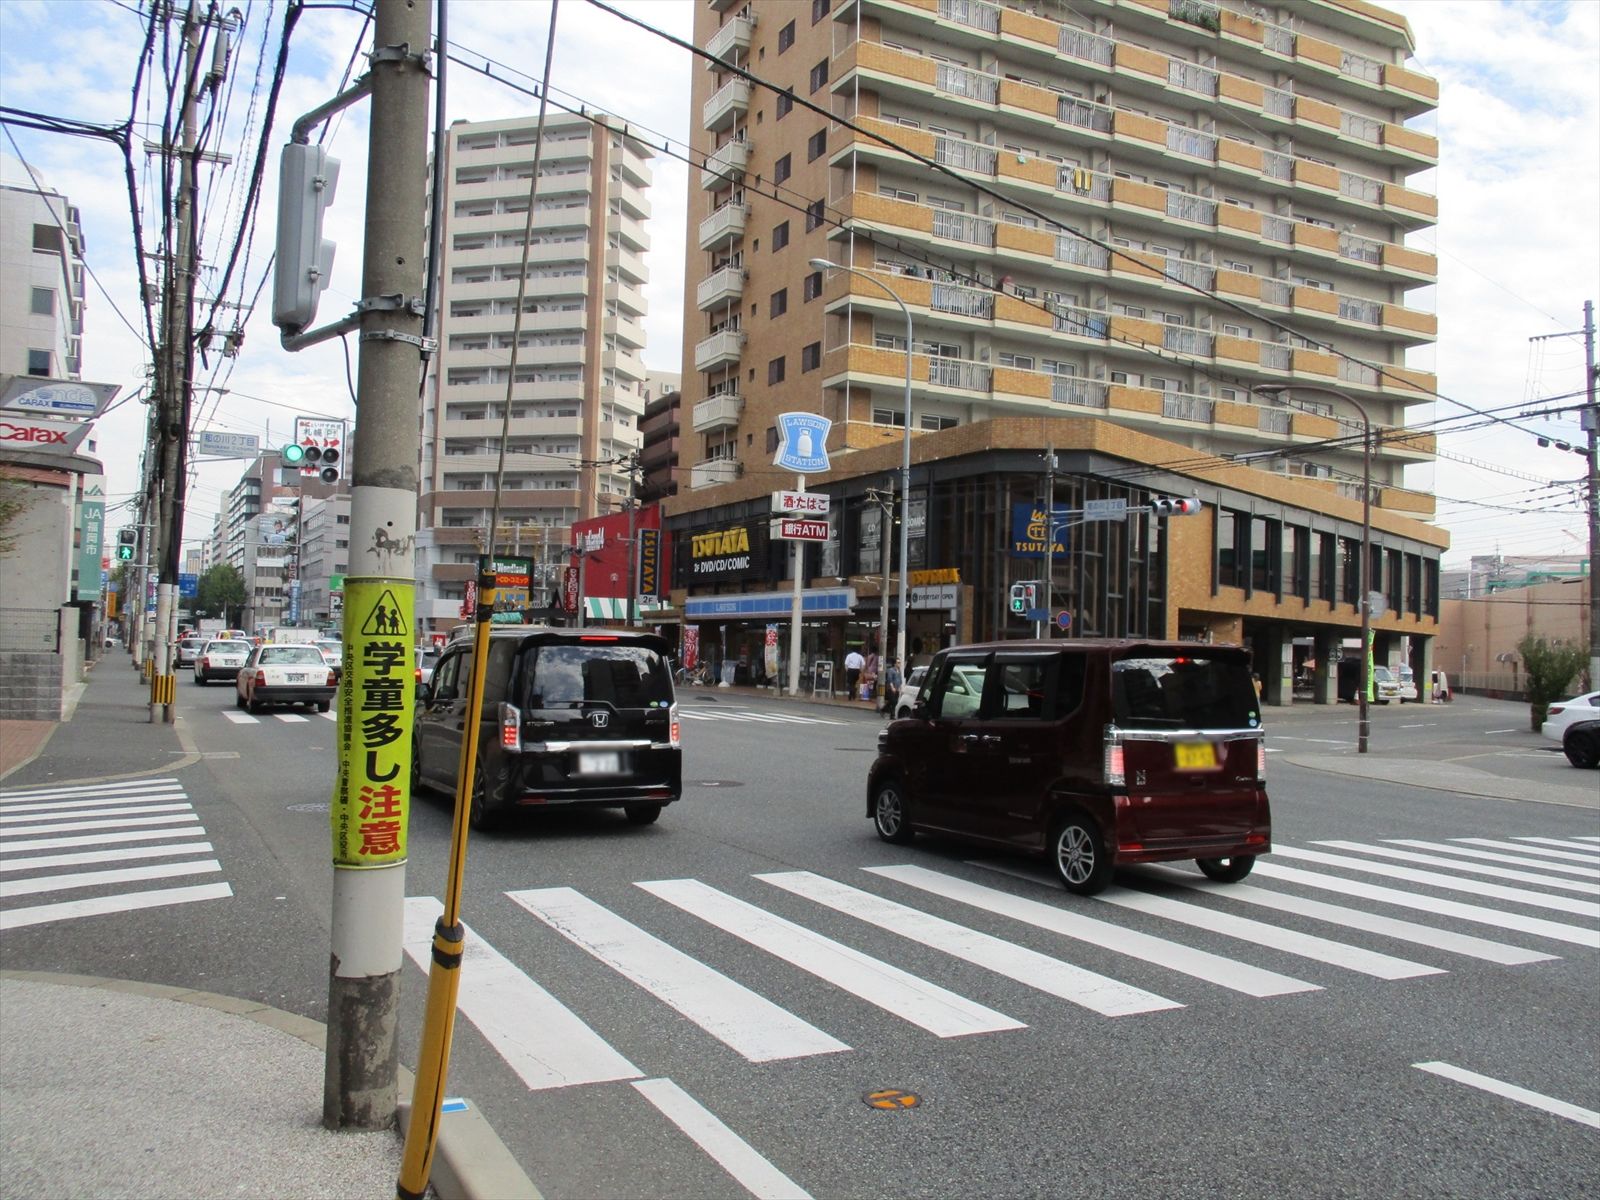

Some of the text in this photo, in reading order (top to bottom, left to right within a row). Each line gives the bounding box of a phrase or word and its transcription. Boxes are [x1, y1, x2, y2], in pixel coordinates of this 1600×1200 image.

[786, 419, 825, 430] LAWSON
[0, 423, 68, 444] Carax
[785, 454, 825, 466] STATION
[84, 508, 102, 519] JA
[784, 523, 826, 537] 銀行ATM
[691, 527, 750, 558] TSUTAYA
[642, 531, 656, 593] TSUTAYA
[357, 641, 406, 856] 学童多し注意
